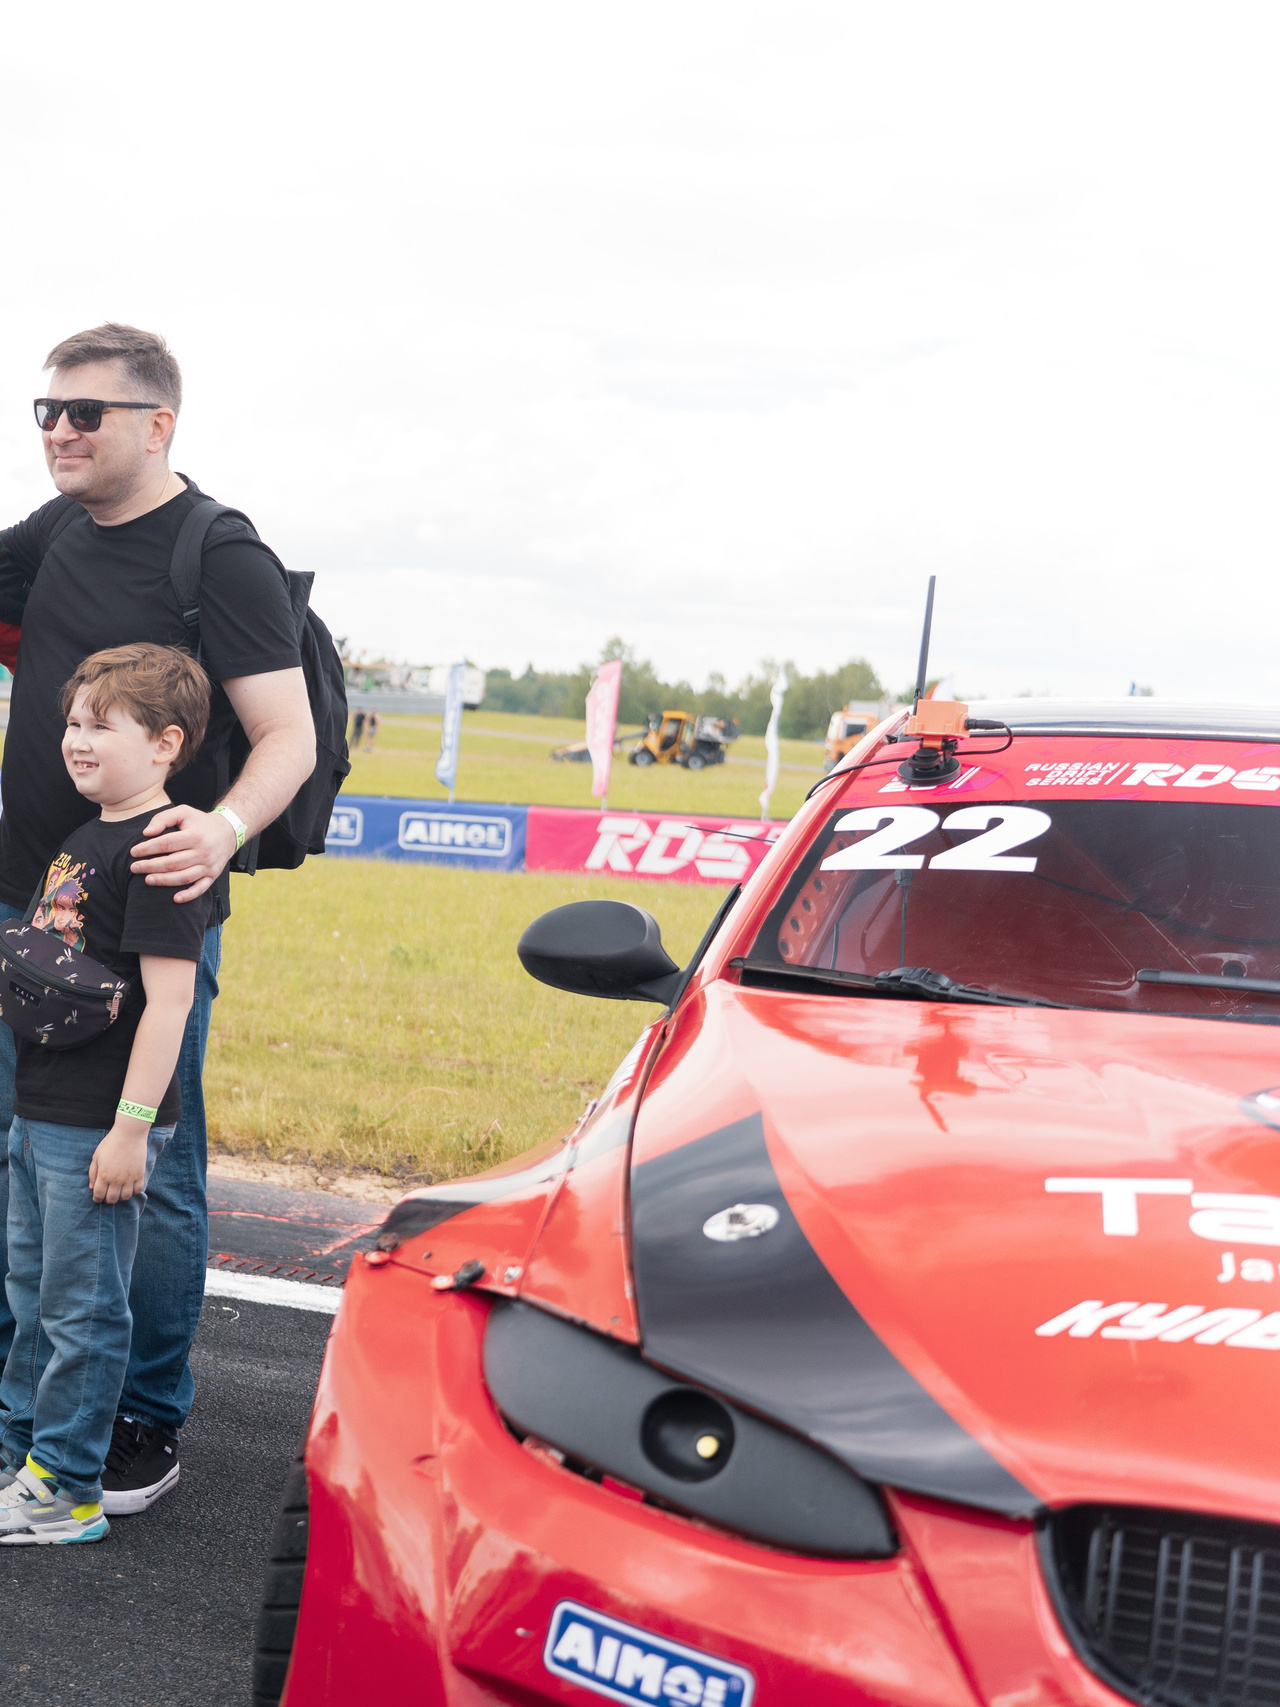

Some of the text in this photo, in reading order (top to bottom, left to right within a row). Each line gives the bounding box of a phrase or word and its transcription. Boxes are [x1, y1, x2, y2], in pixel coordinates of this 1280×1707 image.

[1024, 761, 1121, 771] RUSSIAN
[1045, 769, 1113, 778] DRIFT
[1121, 762, 1280, 792] RDS
[1025, 777, 1103, 786] SERIES
[403, 818, 506, 850] AIMOL
[584, 817, 752, 879] RDS
[819, 805, 1052, 873] 22
